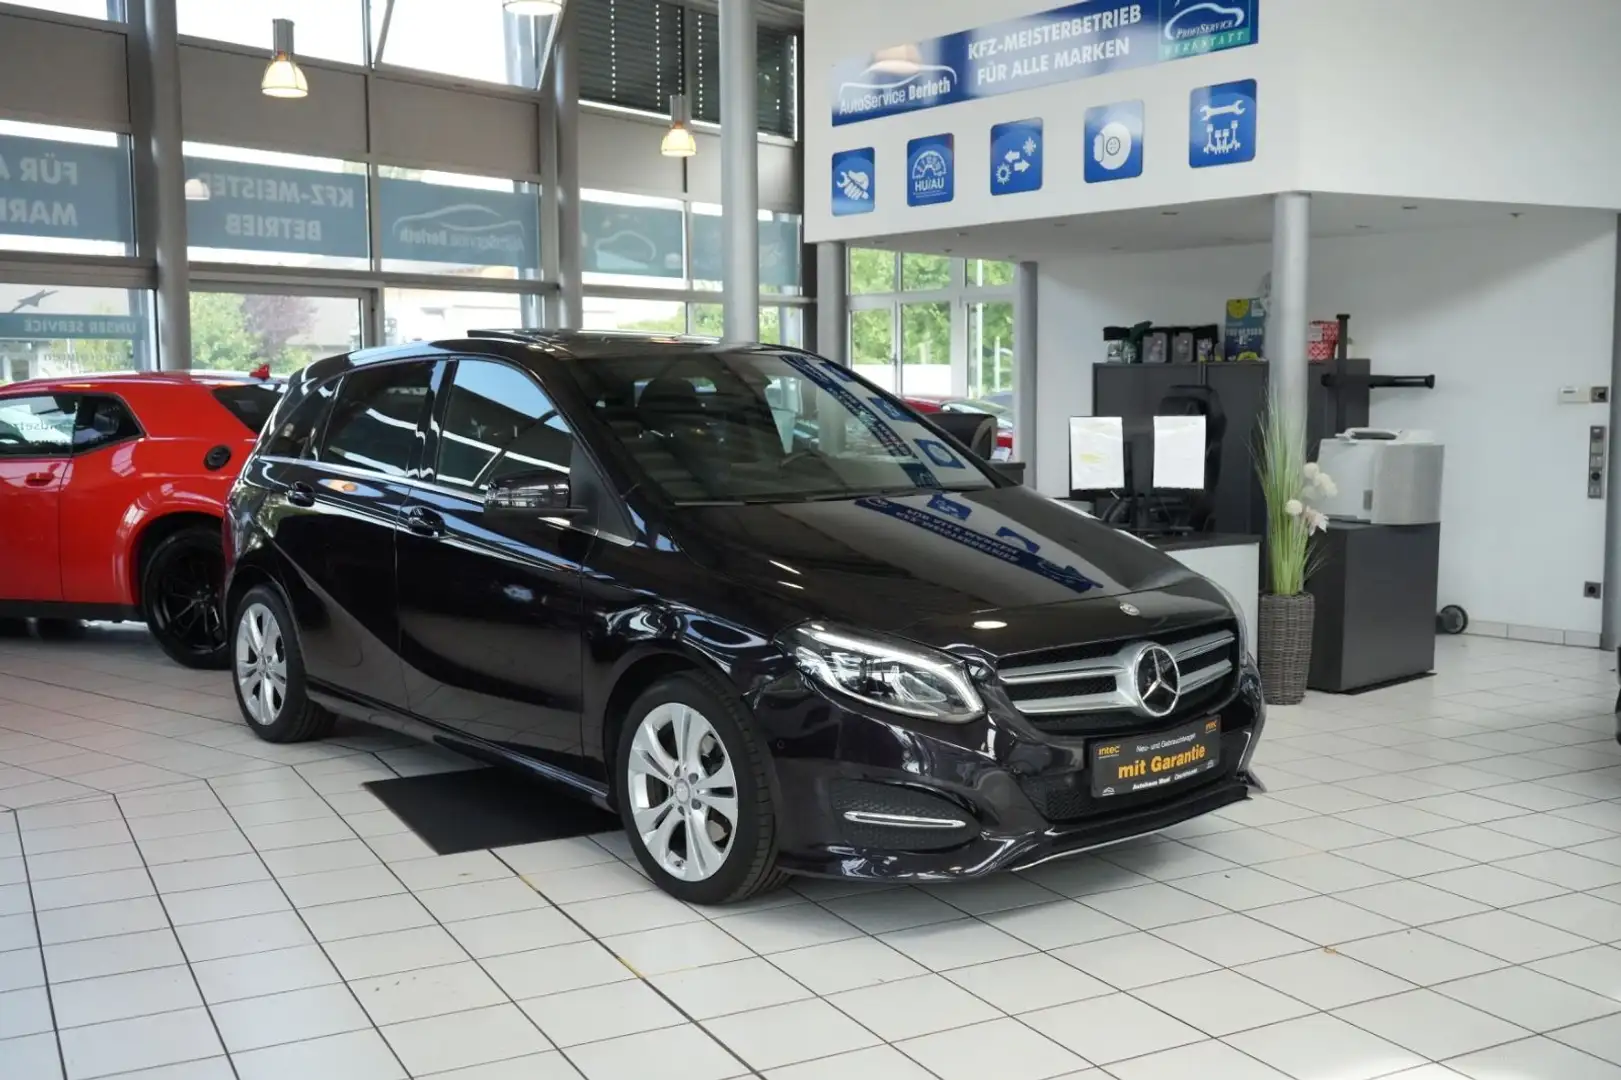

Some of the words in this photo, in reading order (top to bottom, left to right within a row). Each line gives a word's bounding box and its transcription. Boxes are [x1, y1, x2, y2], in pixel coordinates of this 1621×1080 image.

[968, 4, 1141, 60] KFZ-MEISTERBETRIEB
[977, 59, 1007, 86] FÜR
[1011, 54, 1049, 79] ALLE
[1054, 36, 1130, 69] MARKEN
[839, 88, 906, 116] AutoService
[1118, 759, 1146, 779] mit
[1151, 744, 1206, 773] Garantie
